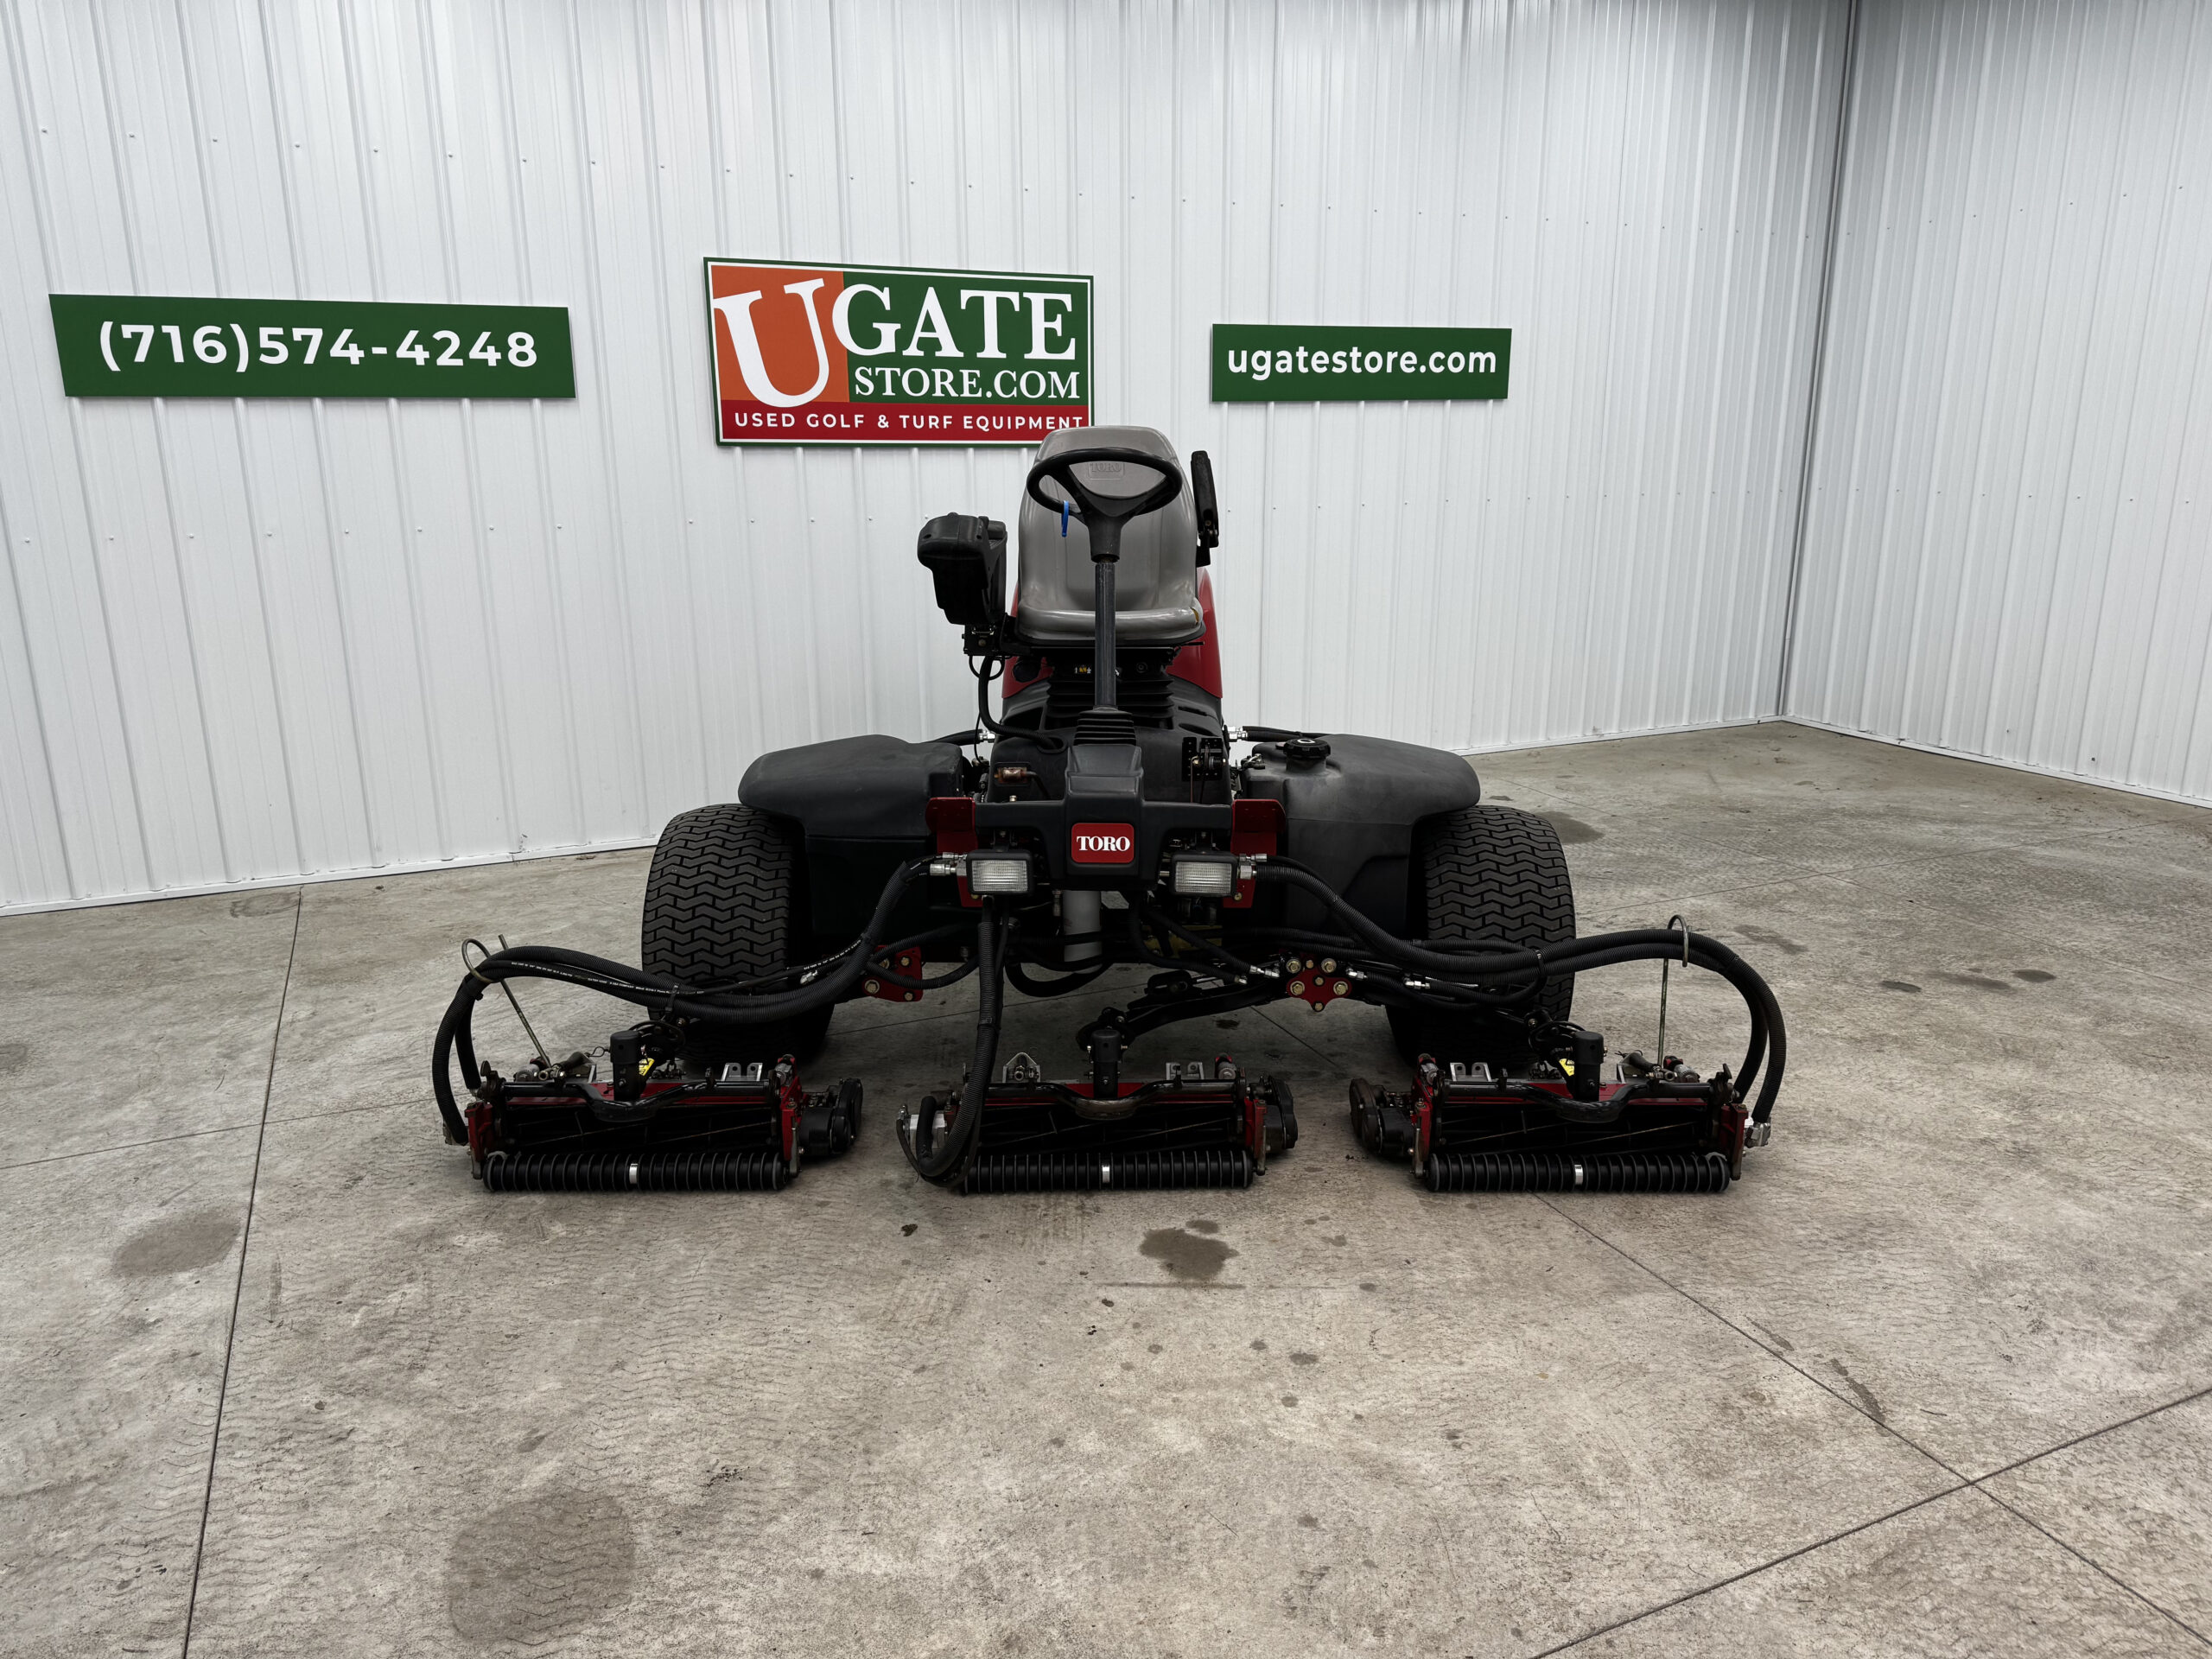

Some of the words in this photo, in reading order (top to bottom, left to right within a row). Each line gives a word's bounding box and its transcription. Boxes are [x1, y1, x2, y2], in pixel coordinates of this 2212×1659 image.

[99, 321, 538, 372] (716)574-4248
[1228, 346, 1497, 381] ugatestore.com
[855, 366, 1080, 399] STORE.COM
[734, 412, 795, 428] USED
[806, 413, 864, 429] GOLF
[877, 414, 889, 429] &
[899, 415, 952, 429] TURF
[963, 416, 1083, 432] EQUIPMENT
[1076, 836, 1130, 852] TORO
